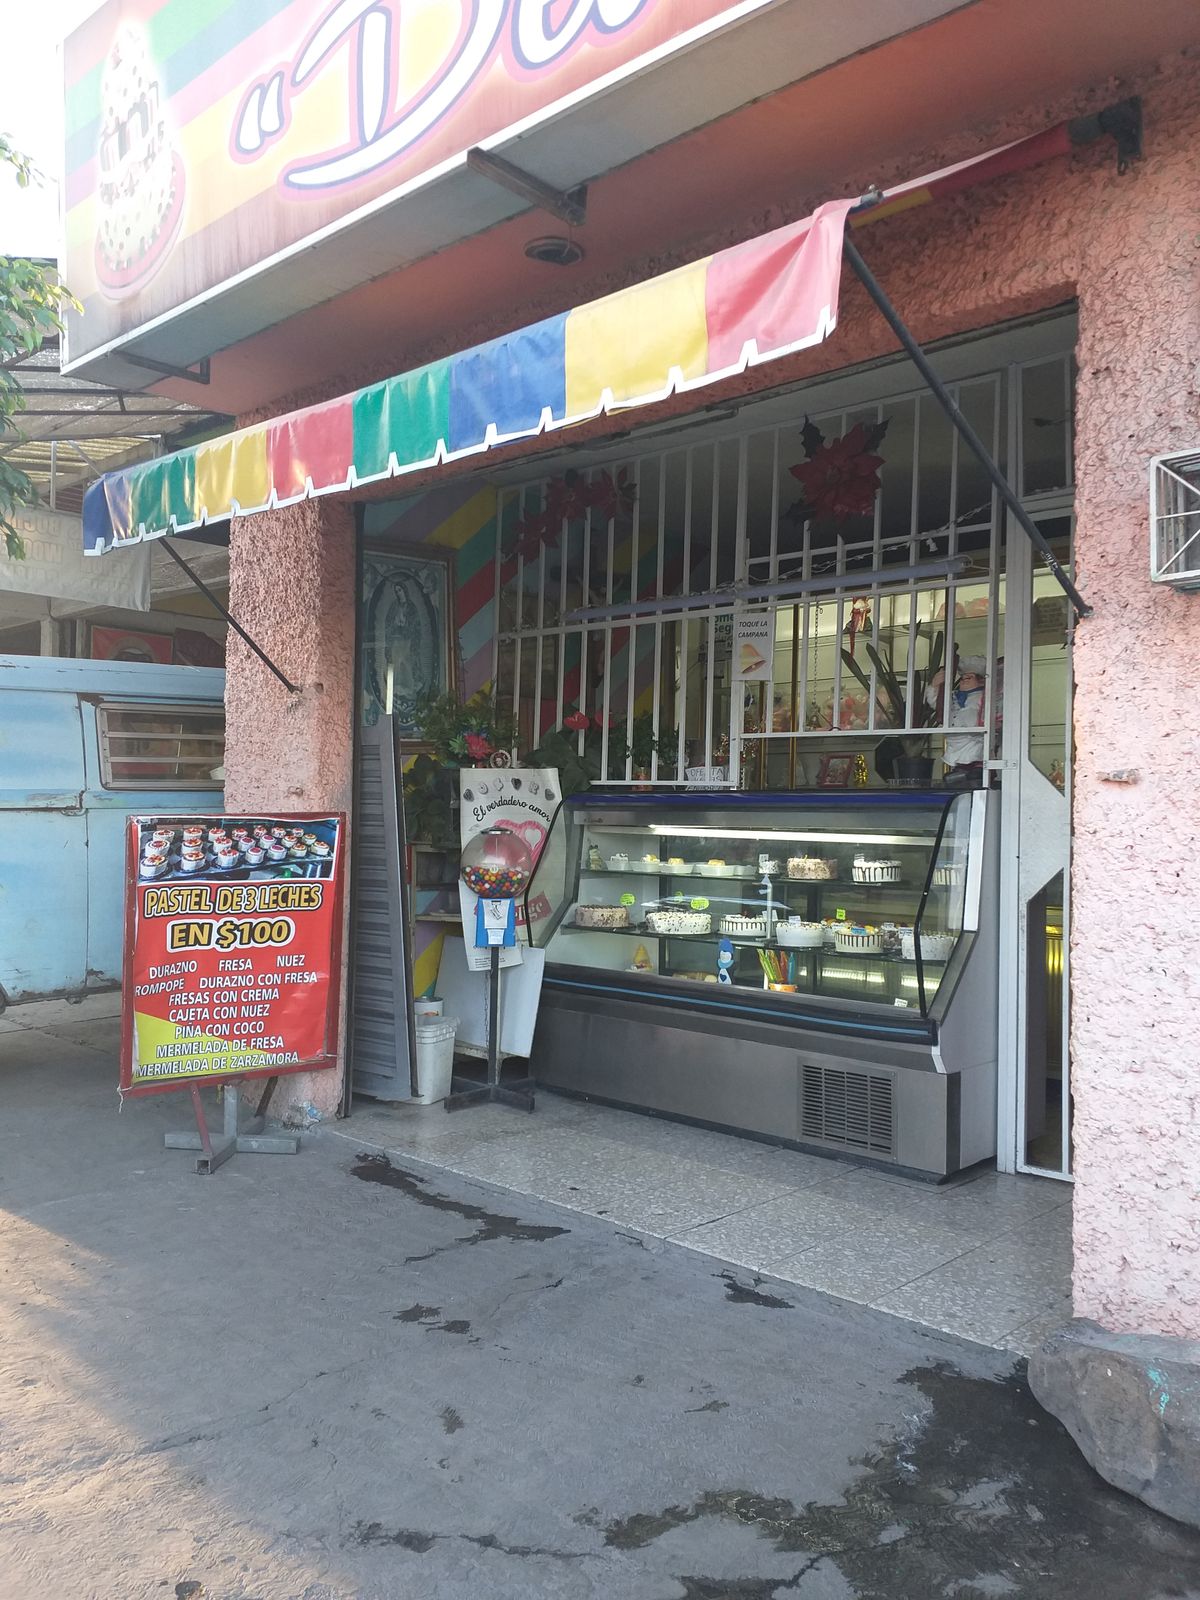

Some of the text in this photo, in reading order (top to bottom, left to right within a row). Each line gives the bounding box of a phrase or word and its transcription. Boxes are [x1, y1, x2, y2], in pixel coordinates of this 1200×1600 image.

[737, 631, 769, 639] CAMPANA
[739, 620, 759, 628] TOQUE
[472, 795, 551, 823] El verdadero amor
[145, 885, 213, 918] PASTEL
[217, 886, 244, 914] DE
[258, 883, 322, 912] LECHES
[171, 918, 291, 949] EN $100
[149, 954, 305, 979] DURAZNO FRESA NUEZ
[134, 971, 318, 997] ROMPOPE DURAZNO CON FRESA
[168, 988, 280, 1007] FRESAS CON CREMA
[168, 1004, 270, 1023] CAJETA CON NUEZ
[175, 1021, 265, 1040] PIÑA CON COCO
[156, 1036, 285, 1059] MERMELADA DE FRESA
[136, 1051, 299, 1079] MERMELADA DE ZARZAMORA
